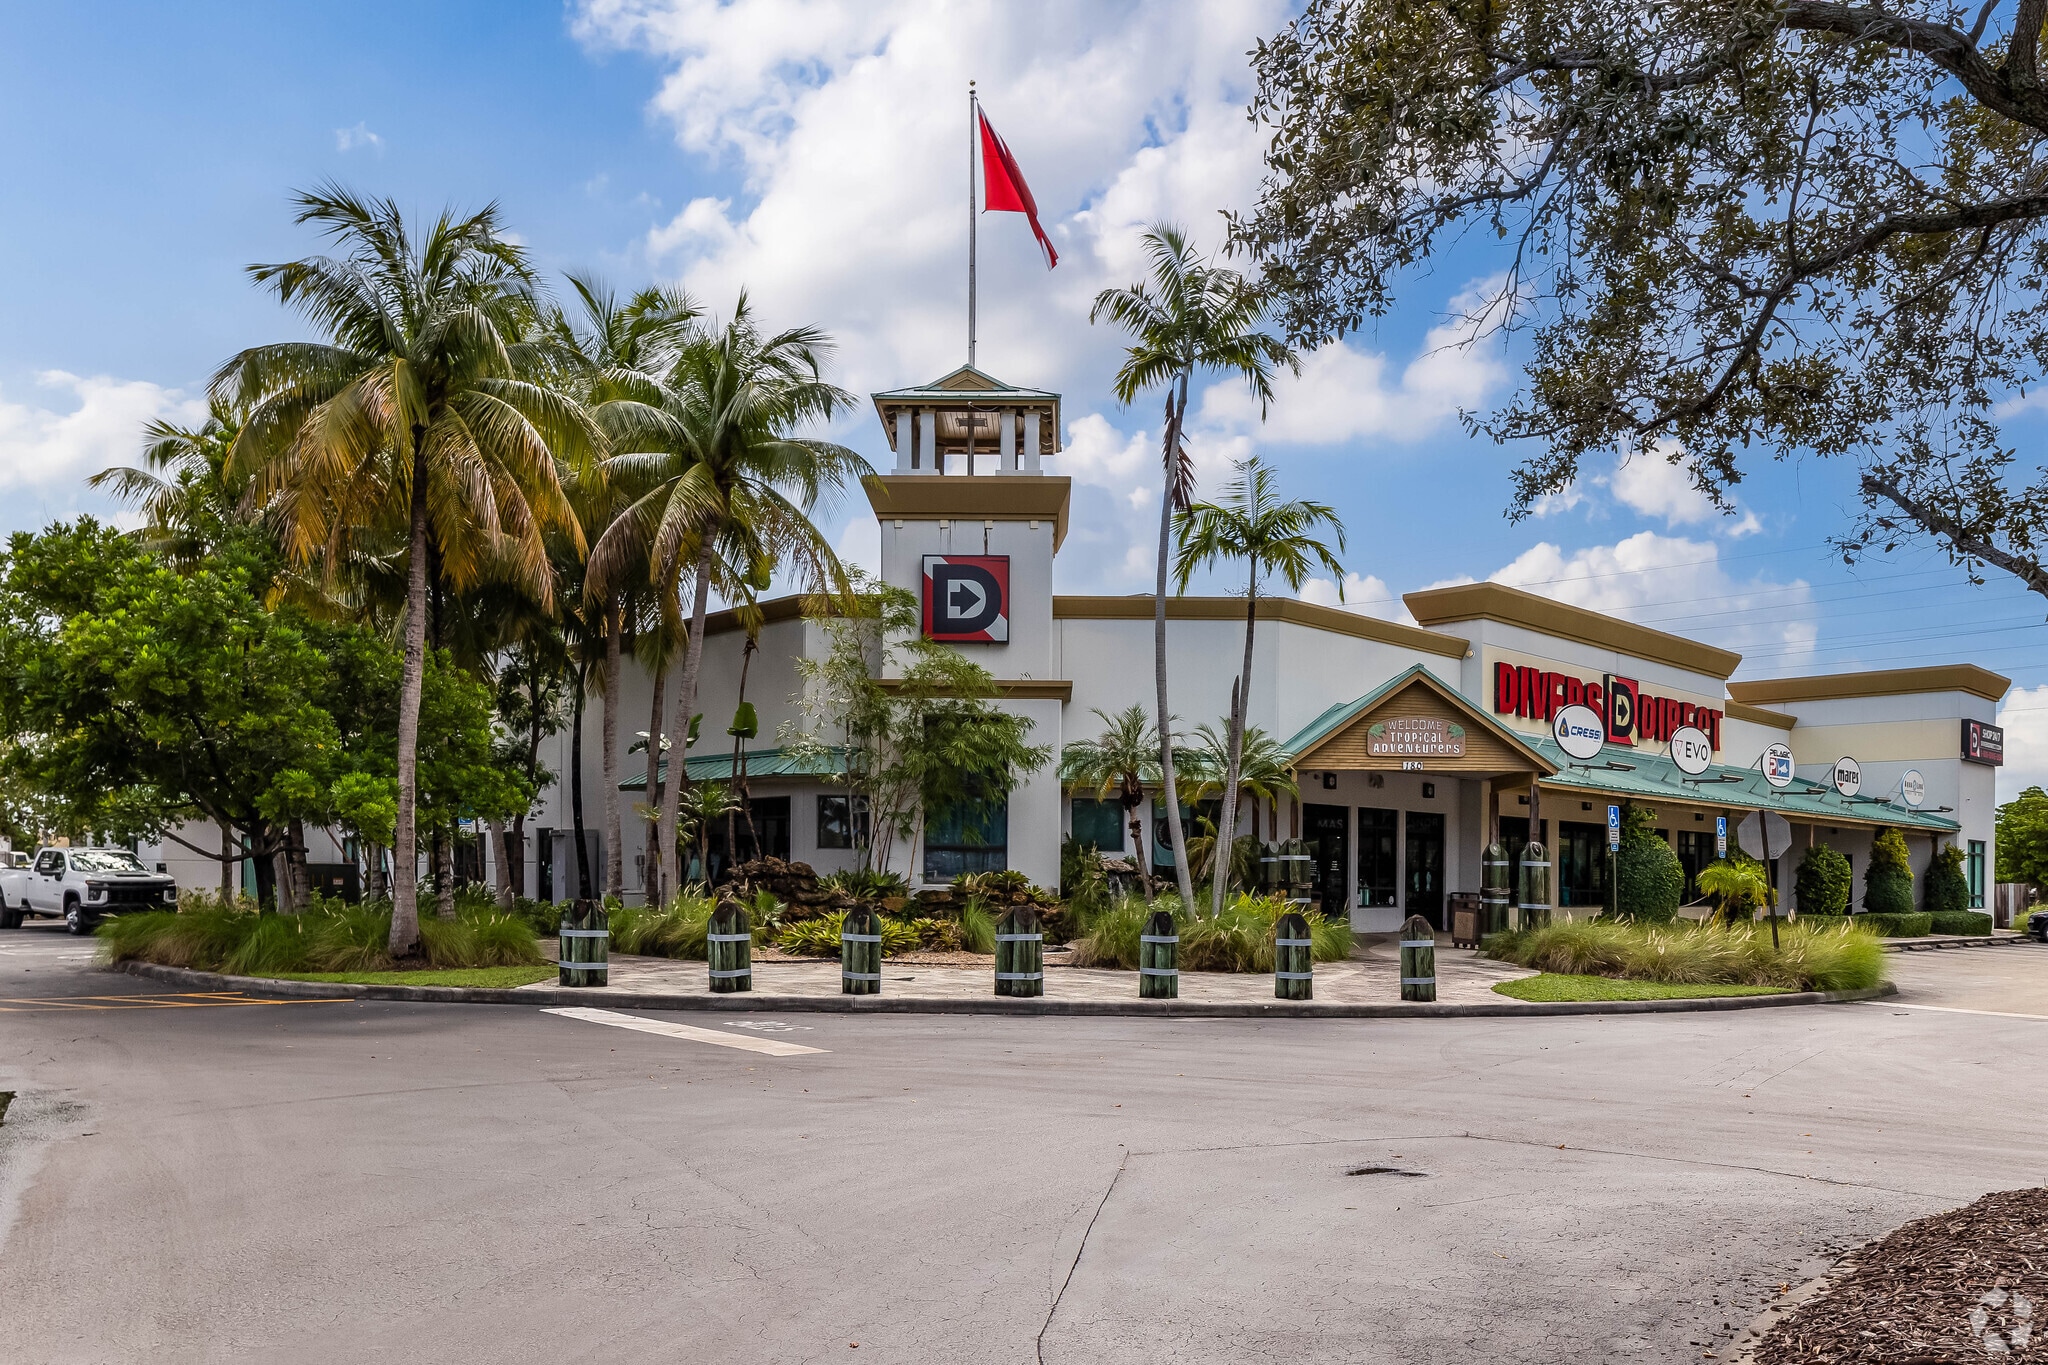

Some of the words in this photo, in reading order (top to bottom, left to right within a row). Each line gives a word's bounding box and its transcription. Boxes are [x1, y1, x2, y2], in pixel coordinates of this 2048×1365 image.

[932, 564, 1002, 634] D
[1388, 720, 1443, 730] WELCOME
[1570, 725, 1602, 740] CRESSI
[1685, 741, 1708, 761] EVO
[1769, 748, 1790, 759] PELAGIC
[1405, 762, 1422, 770] 180
[1837, 769, 1859, 785] mares
